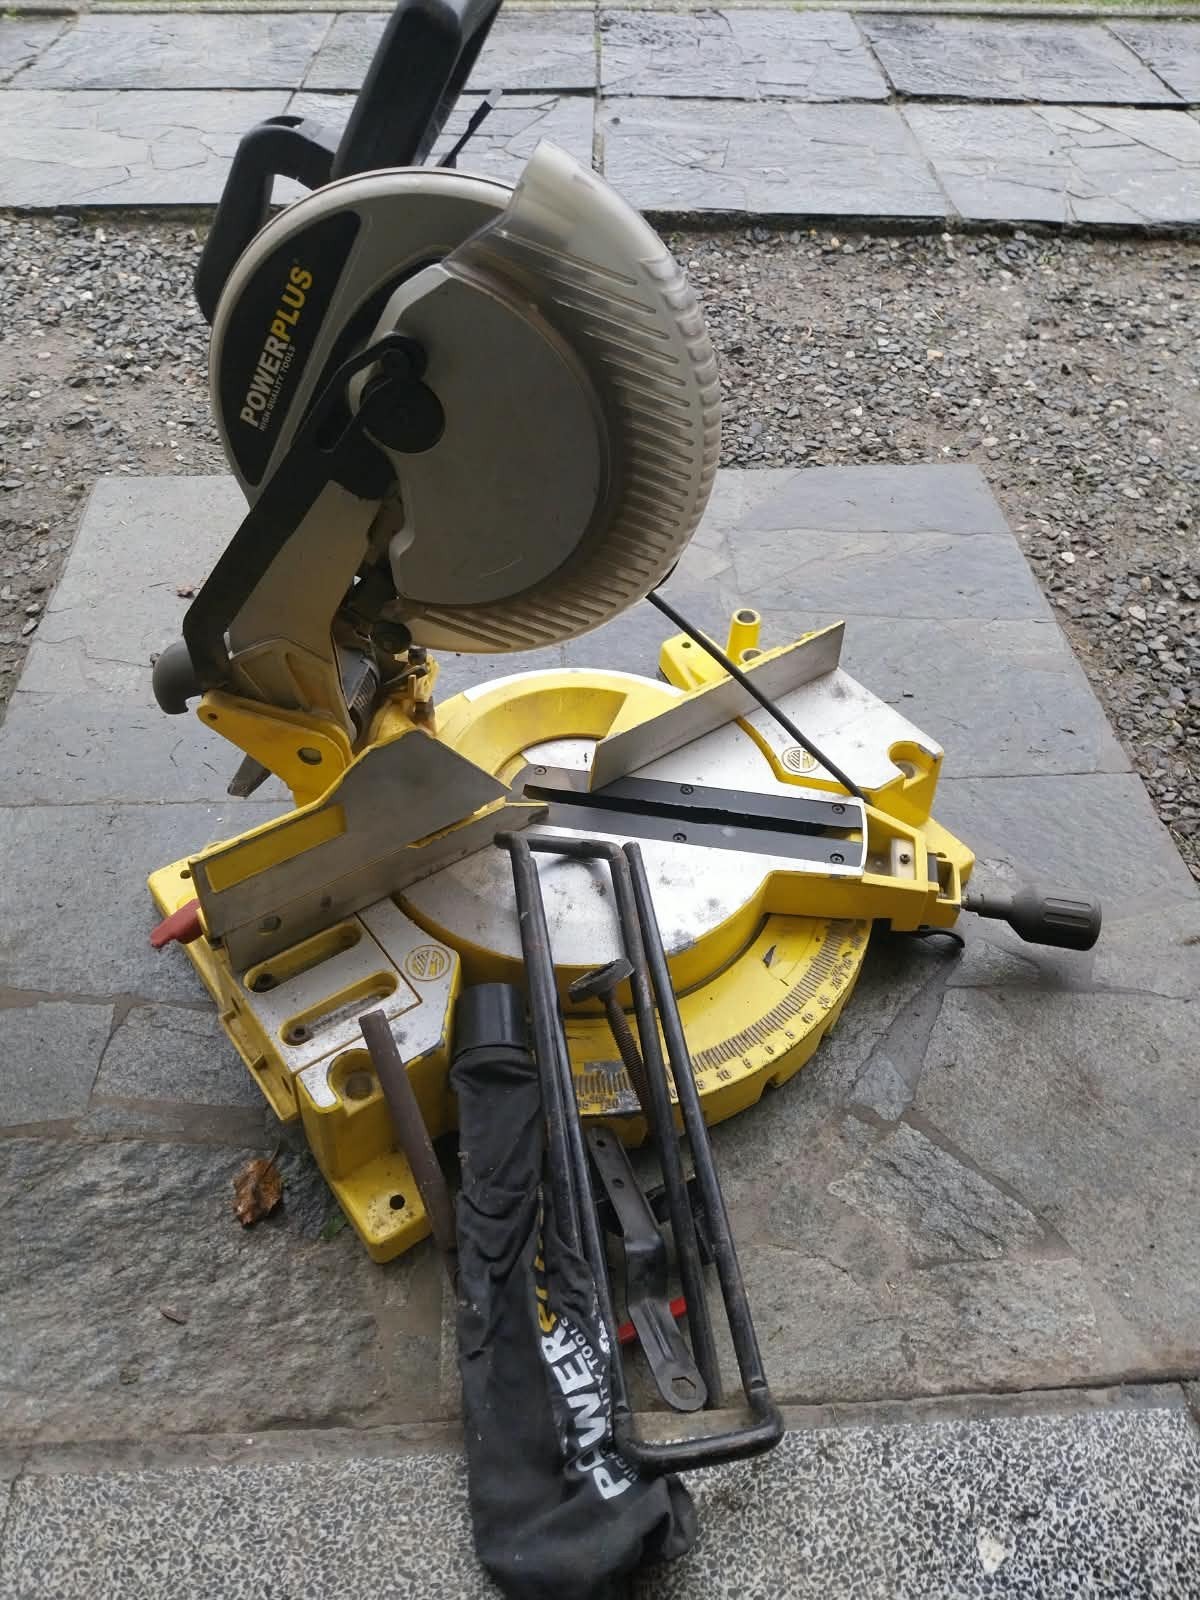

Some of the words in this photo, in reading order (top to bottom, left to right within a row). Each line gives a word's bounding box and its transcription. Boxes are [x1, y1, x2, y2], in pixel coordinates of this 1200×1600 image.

[240, 265, 313, 427] POWERPLUS
[258, 410, 271, 432] HIGH
[267, 375, 284, 410] QUALITY
[280, 345, 296, 375] TOOLS
